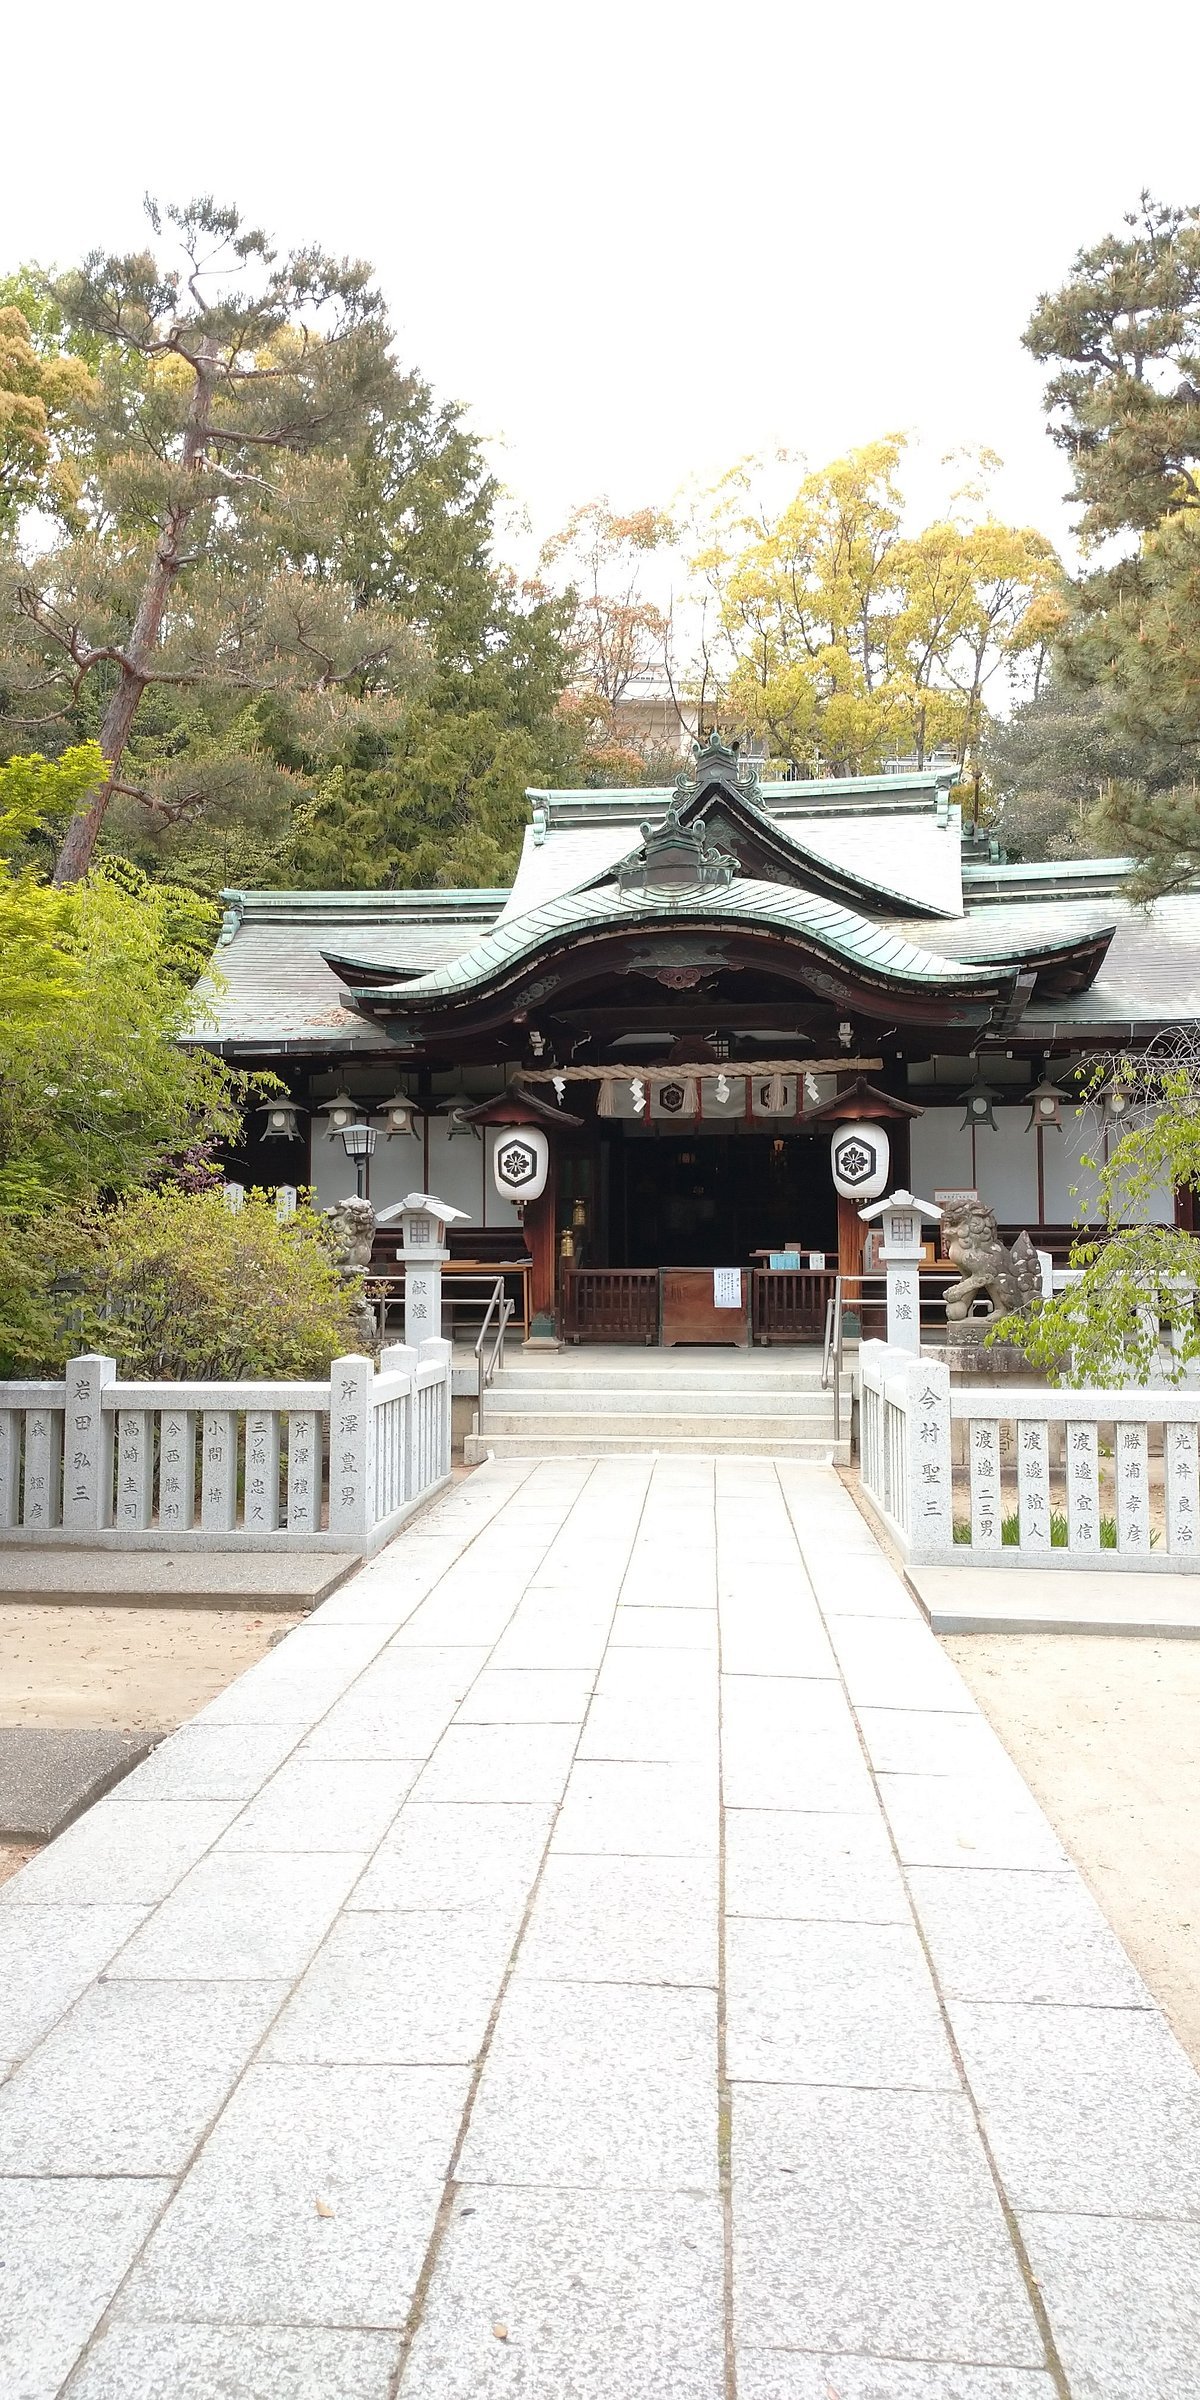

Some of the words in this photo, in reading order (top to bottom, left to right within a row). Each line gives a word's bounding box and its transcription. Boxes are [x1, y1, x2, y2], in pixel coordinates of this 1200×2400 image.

[72, 1380, 92, 1501] 岩田弘三
[163, 1420, 182, 1520] 今西勝利
[918, 1386, 942, 1517] 今村聖三
[1123, 1432, 1143, 1542] 勝浦孝彦
